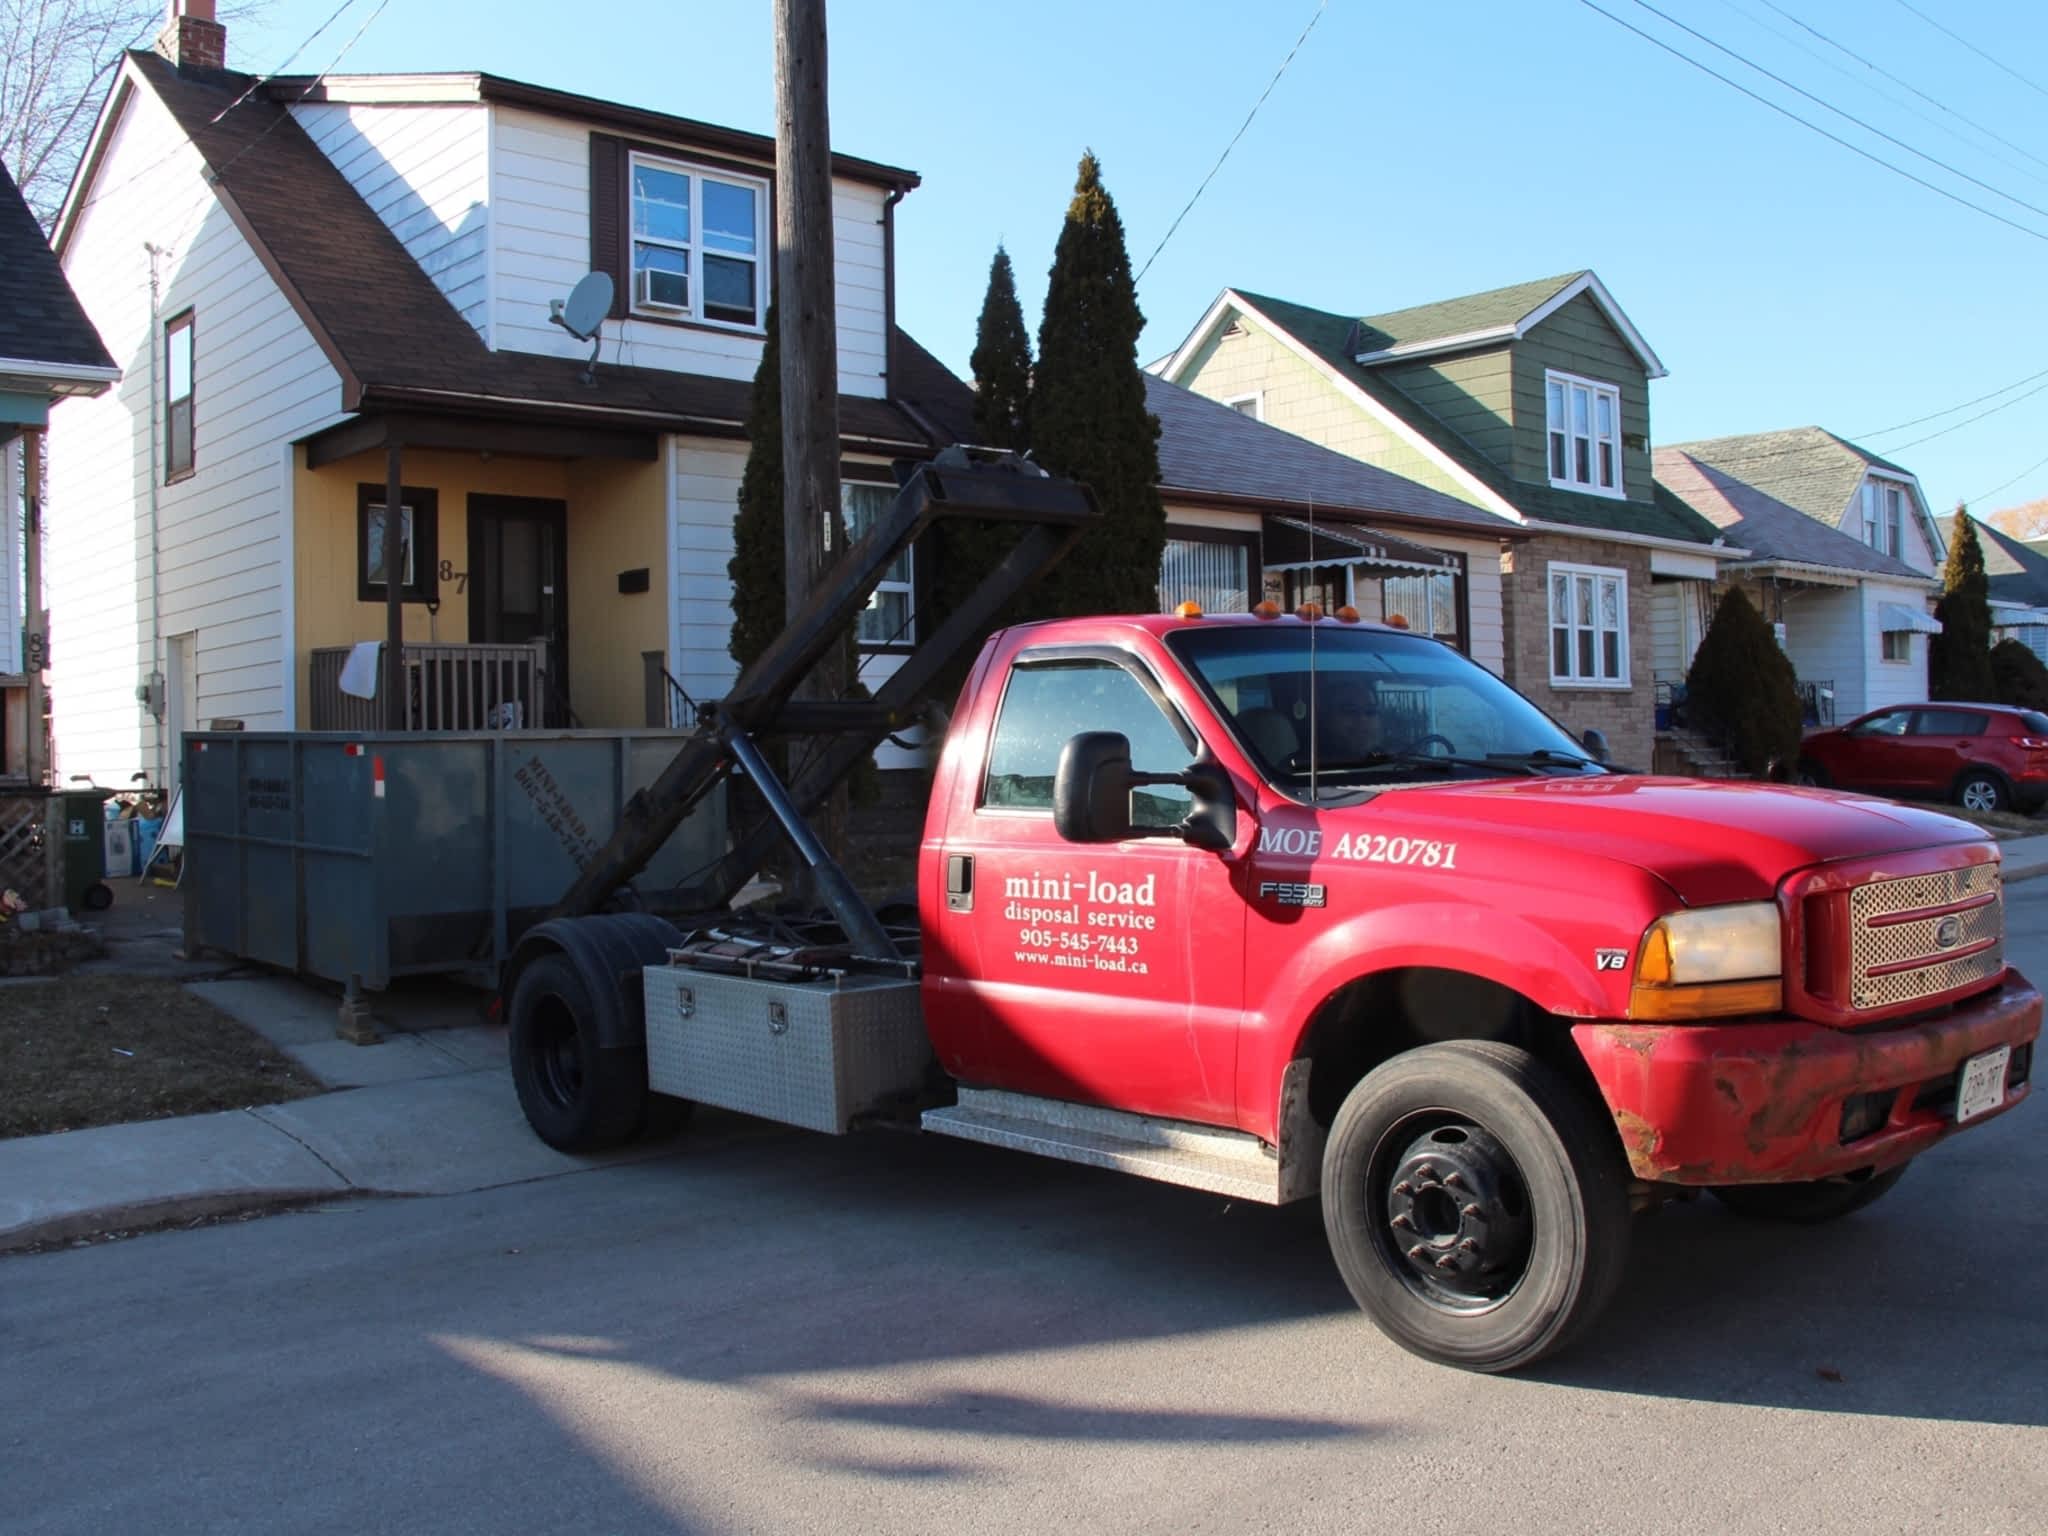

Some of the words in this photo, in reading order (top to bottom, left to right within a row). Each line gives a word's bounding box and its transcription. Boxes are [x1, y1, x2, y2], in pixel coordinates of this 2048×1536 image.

[440, 560, 469, 595] 87
[30, 633, 42, 673] 85
[1258, 826, 1322, 856] MOE
[1331, 832, 1458, 869] A820781
[1004, 870, 1156, 906] mini-load
[1004, 901, 1080, 927] disposal
[1087, 910, 1156, 930] service
[1020, 928, 1139, 955] 905-545-7443
[1014, 951, 1149, 974] www.mini-load.ca
[1597, 954, 1625, 970] V8
